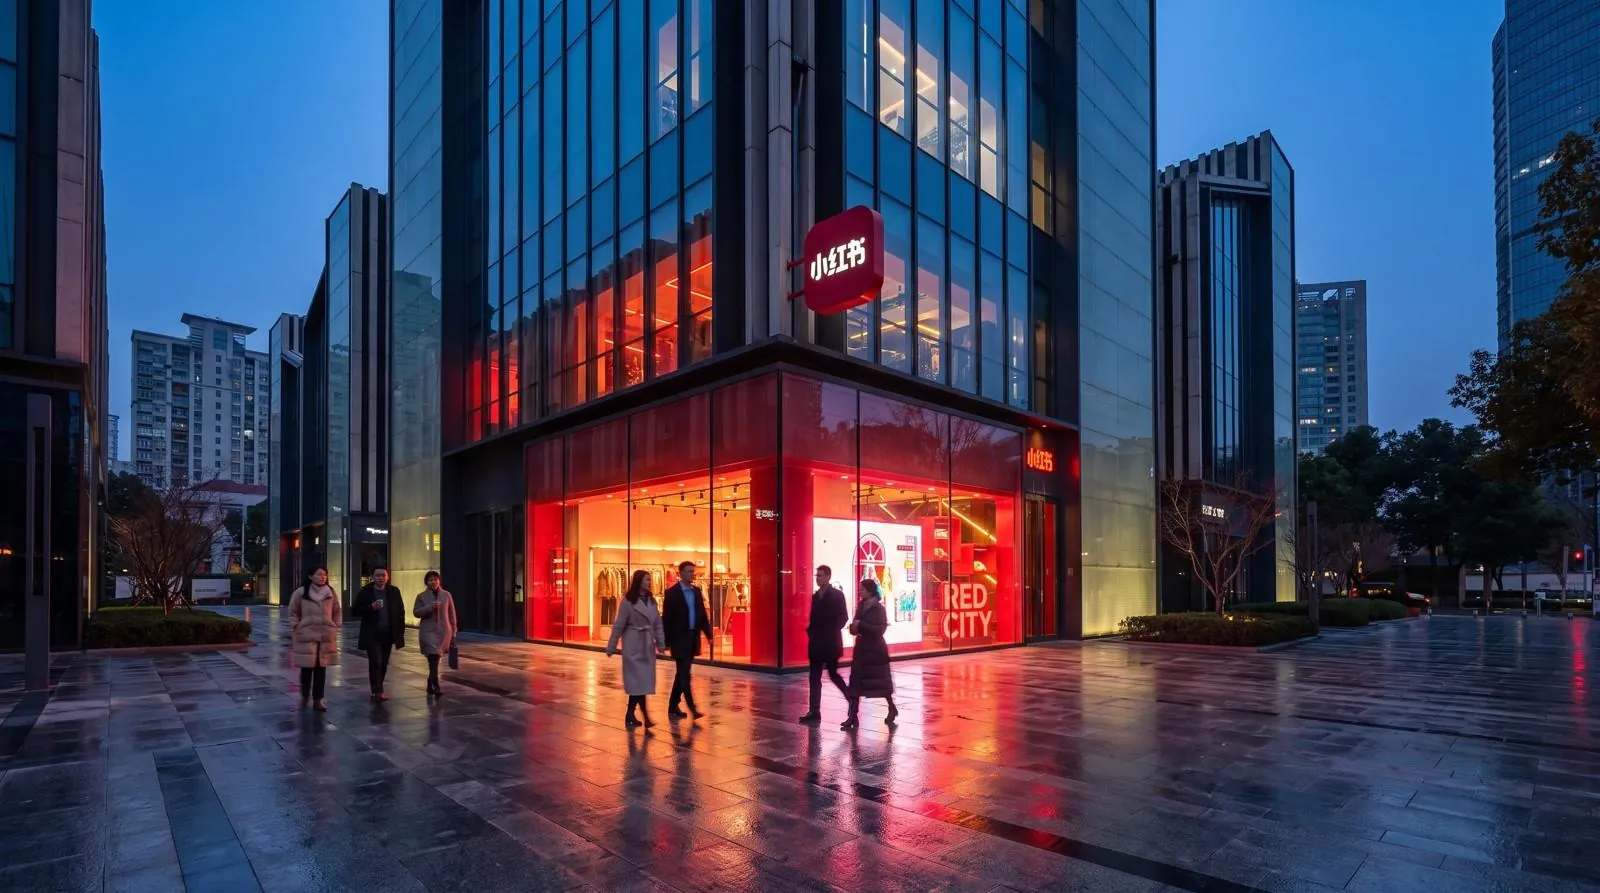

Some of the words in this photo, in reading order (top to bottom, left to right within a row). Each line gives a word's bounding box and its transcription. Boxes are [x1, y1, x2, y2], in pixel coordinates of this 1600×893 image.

[810, 236, 866, 281] 小红书
[1027, 447, 1053, 472] 小红书
[944, 583, 988, 610] RED
[943, 610, 993, 639] CITY
